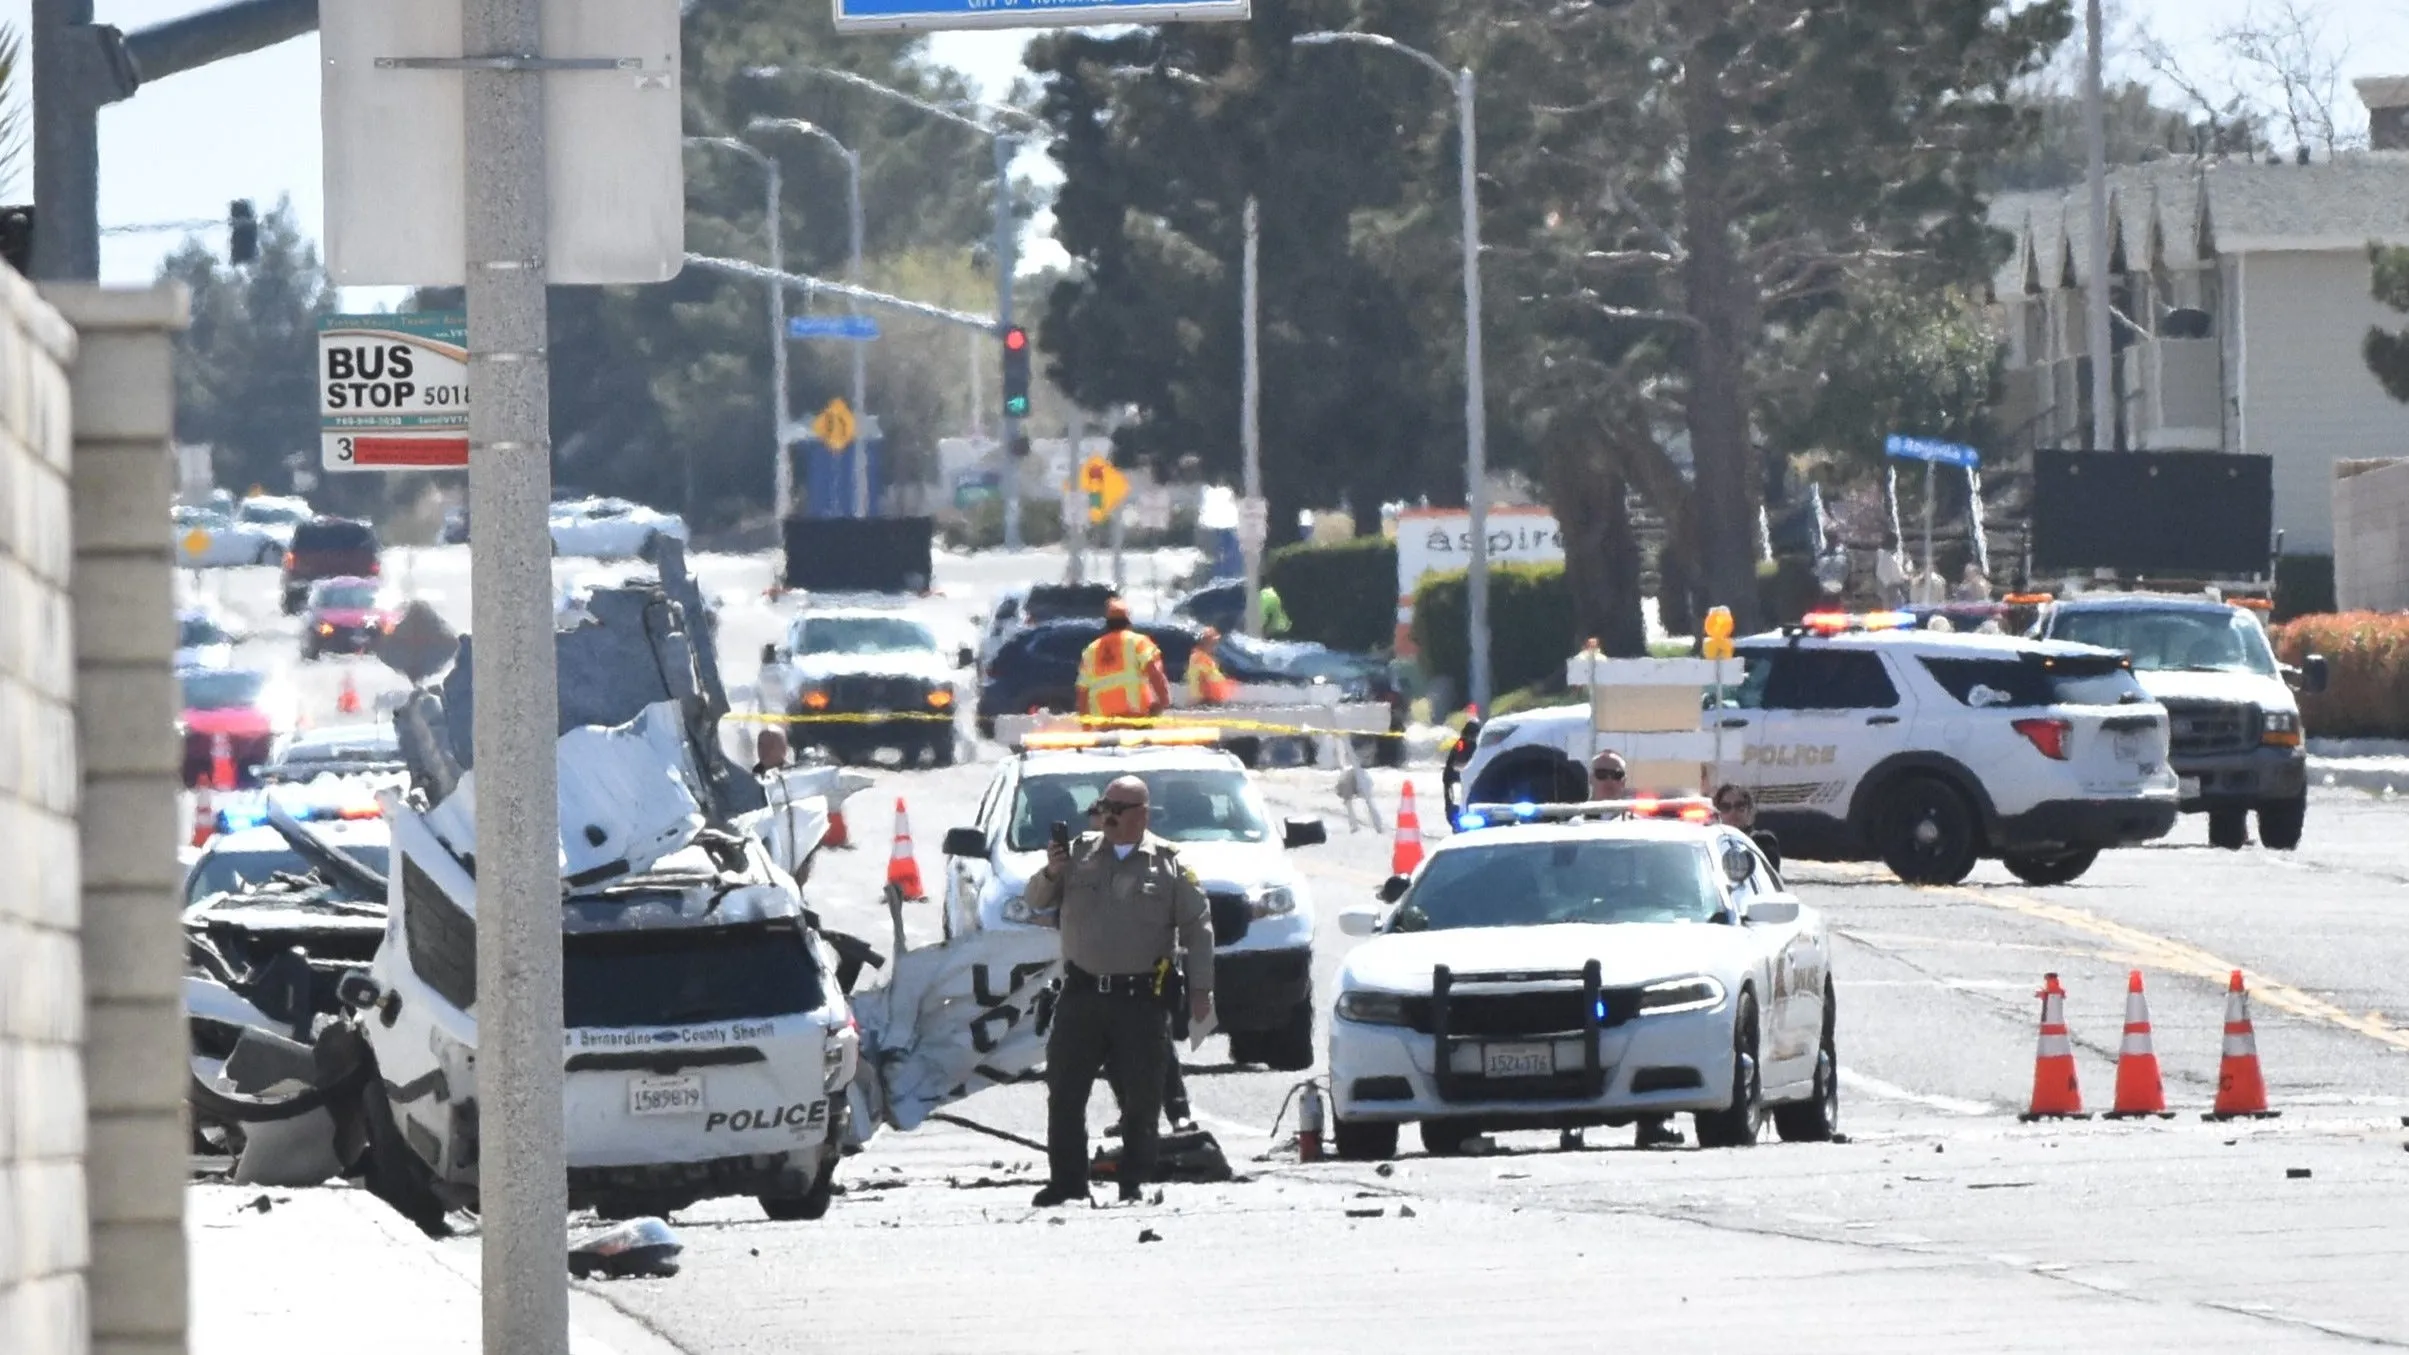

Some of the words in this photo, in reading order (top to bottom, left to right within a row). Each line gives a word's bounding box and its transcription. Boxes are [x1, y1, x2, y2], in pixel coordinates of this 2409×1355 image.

[327, 344, 414, 380] BUS
[327, 381, 416, 409] STOP
[336, 437, 353, 461] 3
[1741, 744, 1838, 767] POLICE
[581, 1030, 652, 1047] Bernardino
[681, 1027, 727, 1044] County
[732, 1021, 776, 1041] Sheriff
[704, 1099, 828, 1133] POLICE
